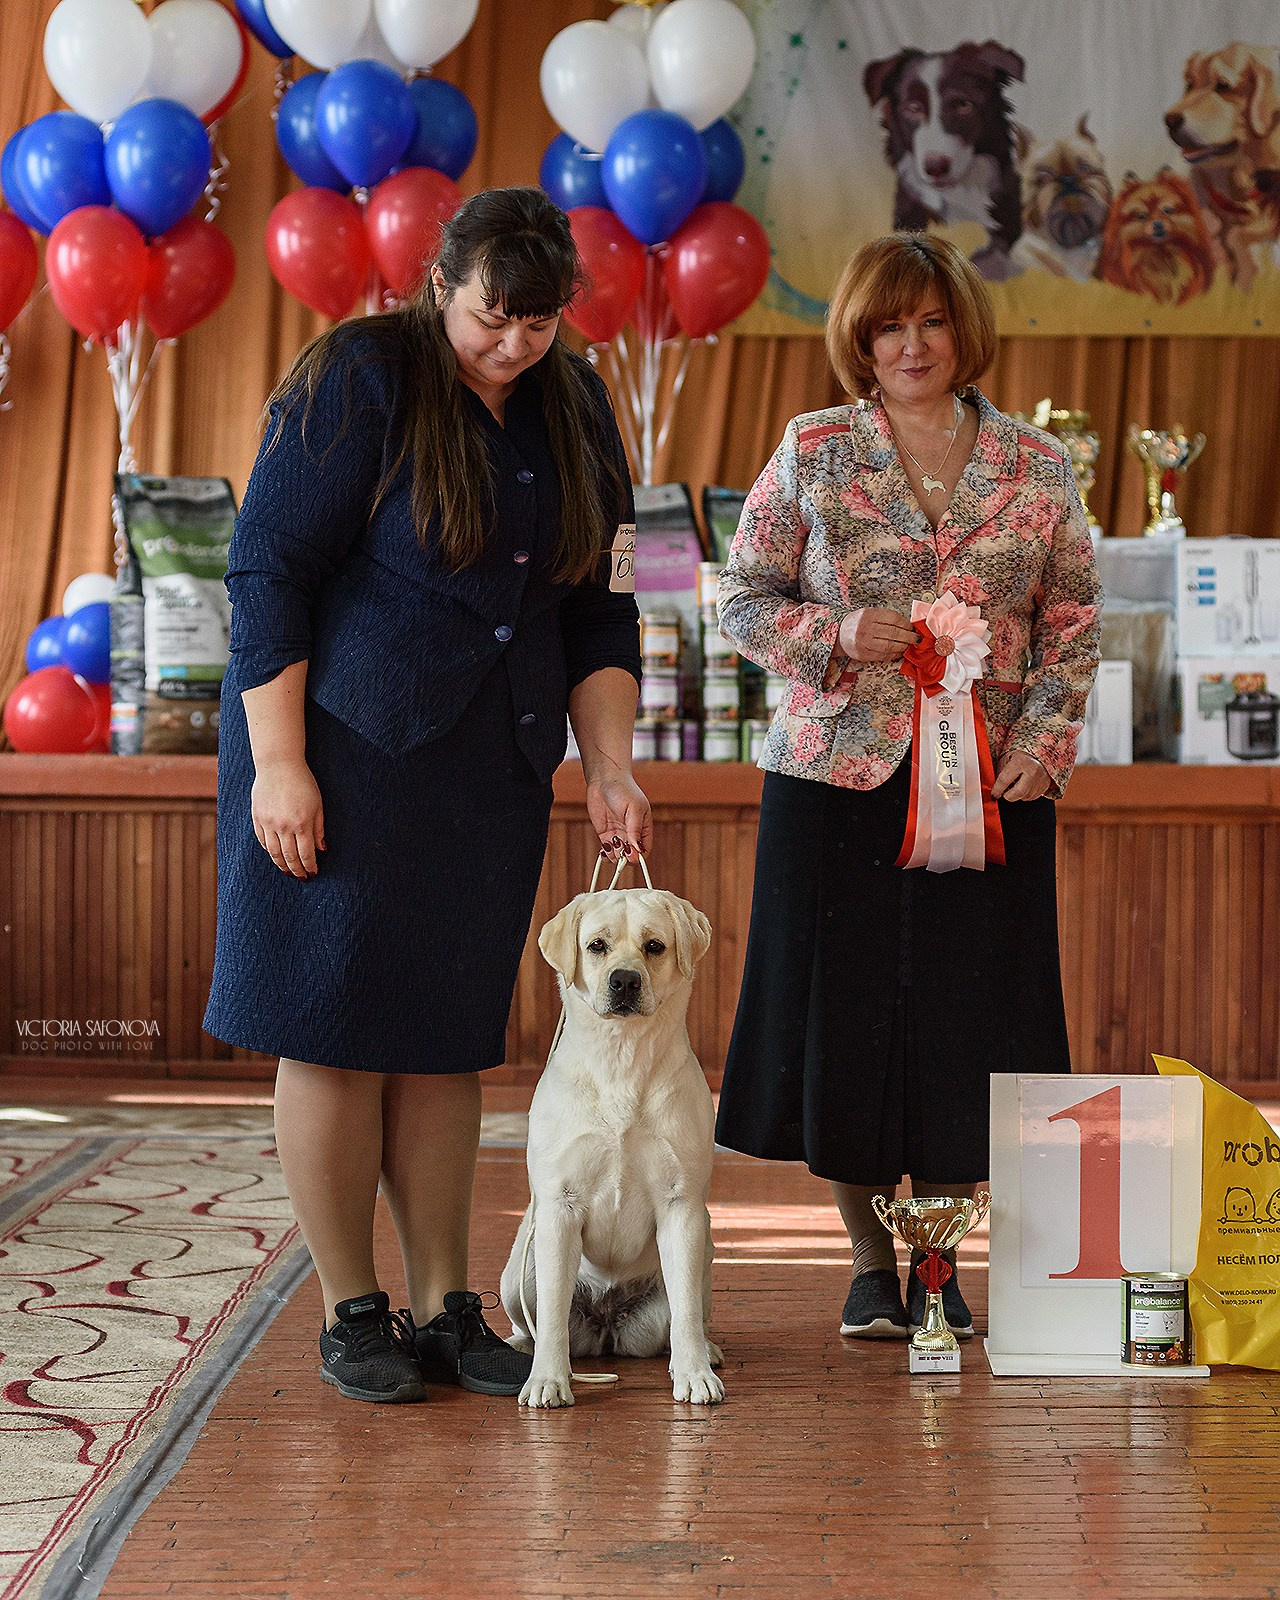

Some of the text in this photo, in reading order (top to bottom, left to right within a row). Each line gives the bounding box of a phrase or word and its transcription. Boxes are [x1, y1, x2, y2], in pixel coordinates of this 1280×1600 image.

[938, 720, 951, 768] GROUP
[949, 732, 958, 768] BEST IN
[948, 773, 953, 784] 1
[1047, 1085, 1133, 1279] 1
[1217, 1253, 1256, 1265] НЕСЁМ
[1134, 1297, 1181, 1307] probalance
